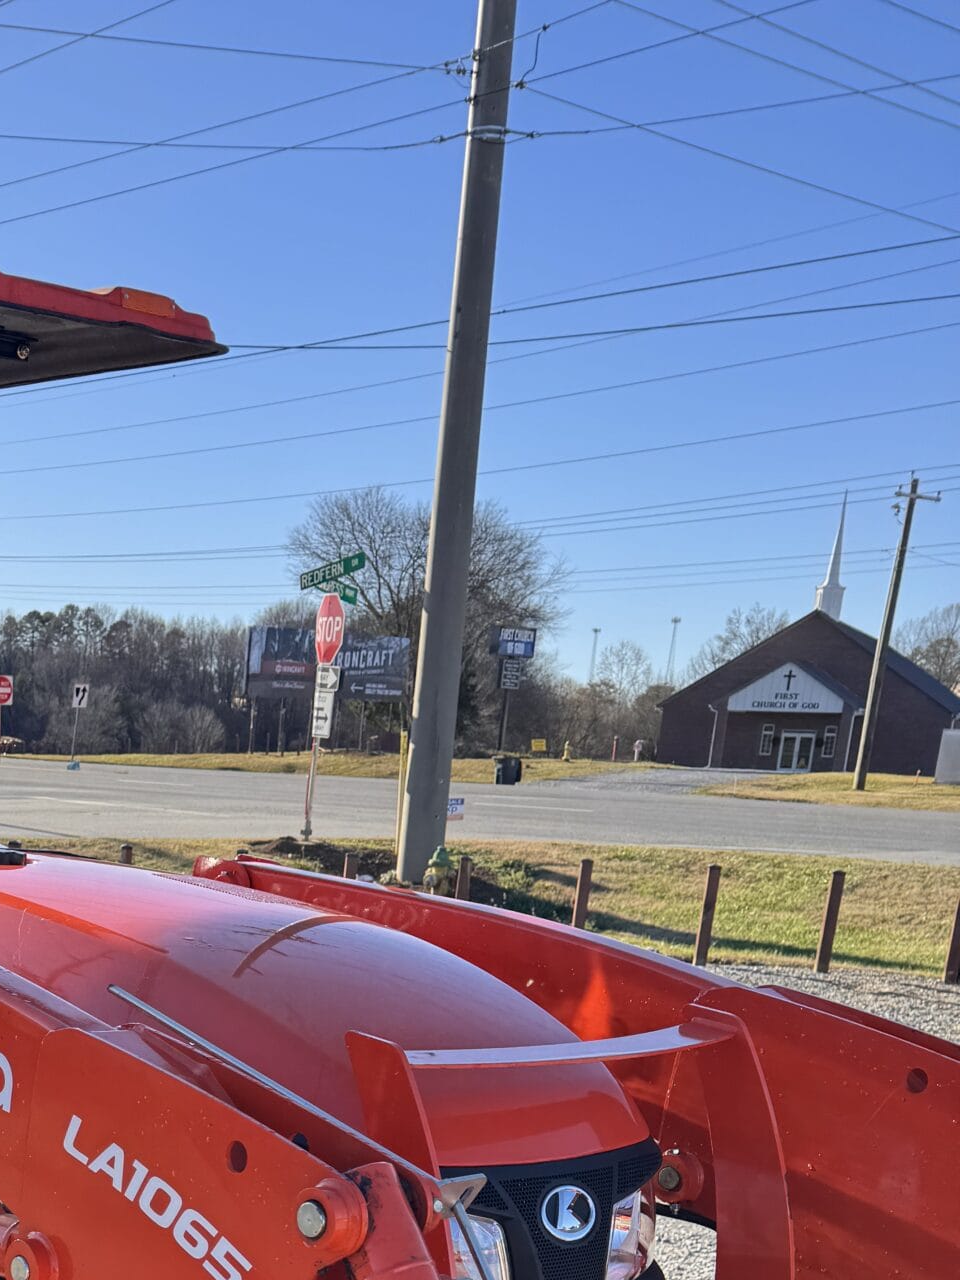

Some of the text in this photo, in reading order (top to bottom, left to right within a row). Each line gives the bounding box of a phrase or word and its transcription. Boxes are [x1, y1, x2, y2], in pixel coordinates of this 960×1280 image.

[301, 562, 344, 589] REDFERN
[316, 616, 342, 643] STOP
[774, 692, 800, 700] FIRST
[751, 701, 786, 709] CHURCH
[801, 702, 820, 710] GOD
